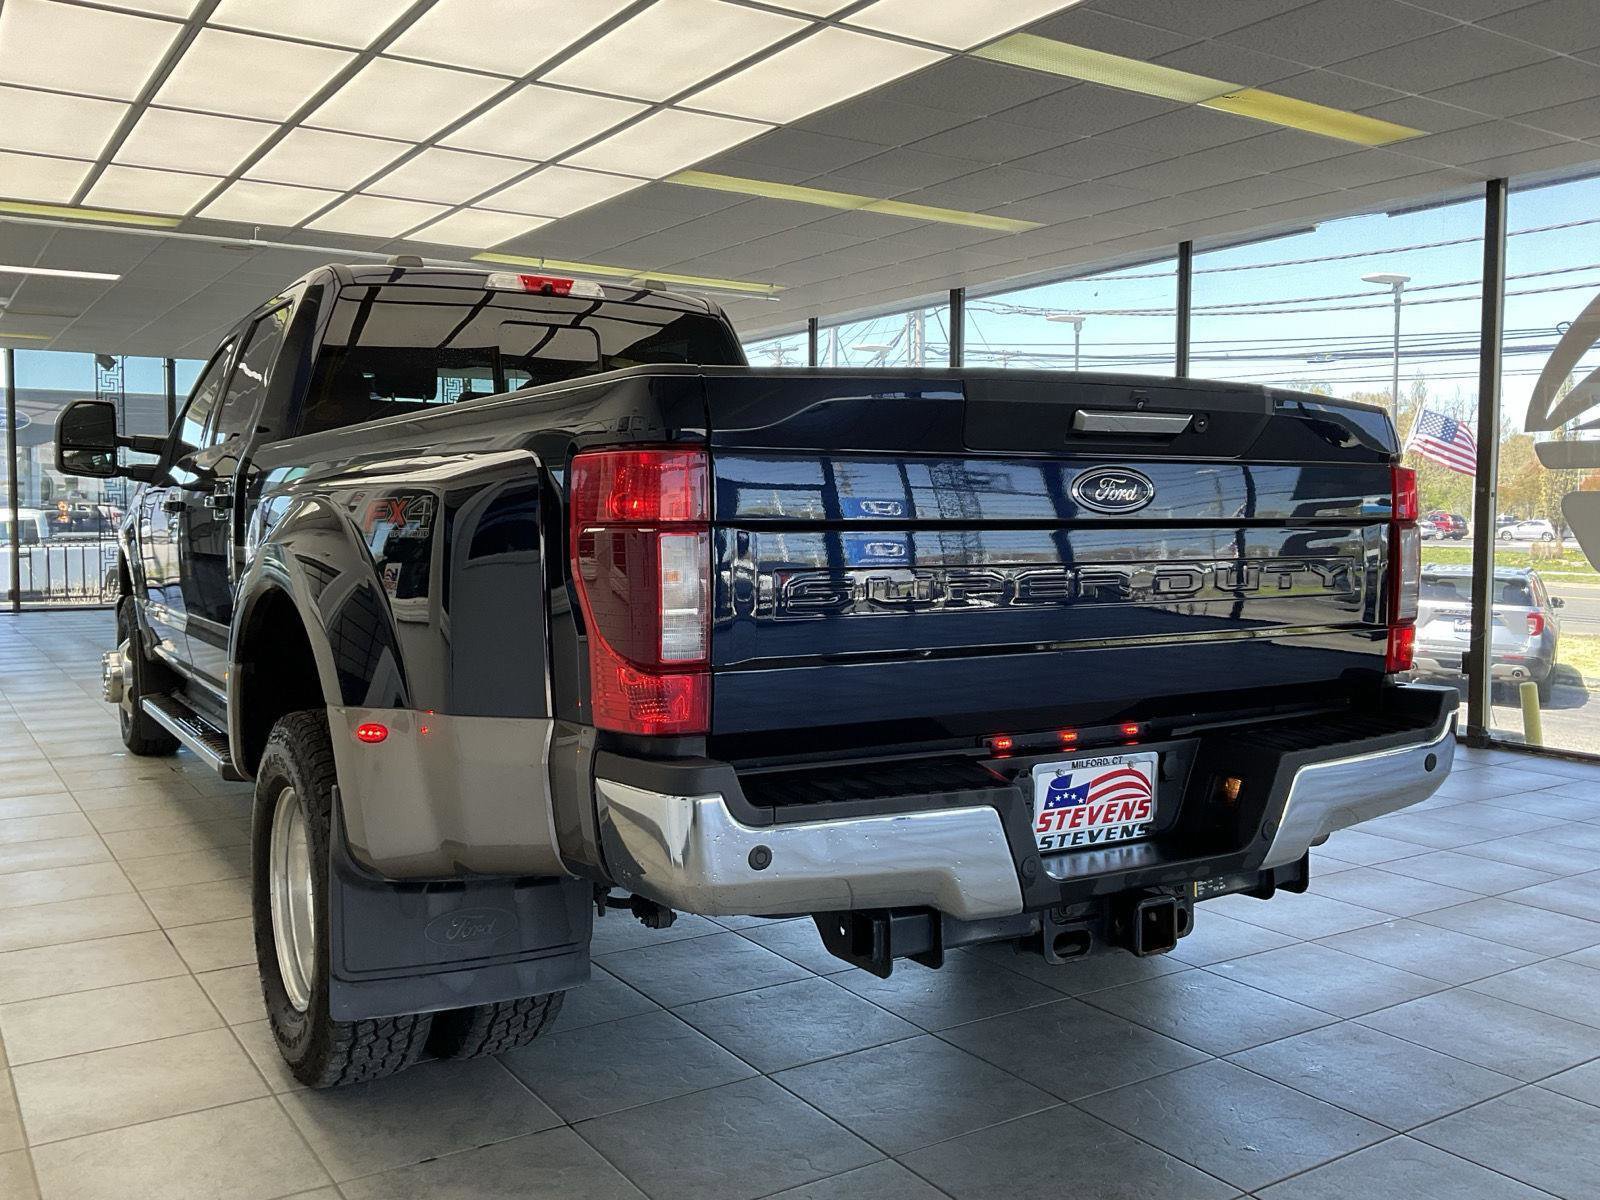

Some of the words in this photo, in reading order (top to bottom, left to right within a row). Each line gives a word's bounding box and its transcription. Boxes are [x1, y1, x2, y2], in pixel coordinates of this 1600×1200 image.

[1094, 477, 1138, 501] Ford
[364, 497, 433, 536] FX4
[785, 566, 1132, 614] SUPER
[1154, 561, 1350, 595] DUTY
[1112, 757, 1123, 766] CT
[1036, 799, 1151, 833] STEVENS
[1038, 823, 1150, 850] STEVENS
[446, 915, 497, 940] Ford
